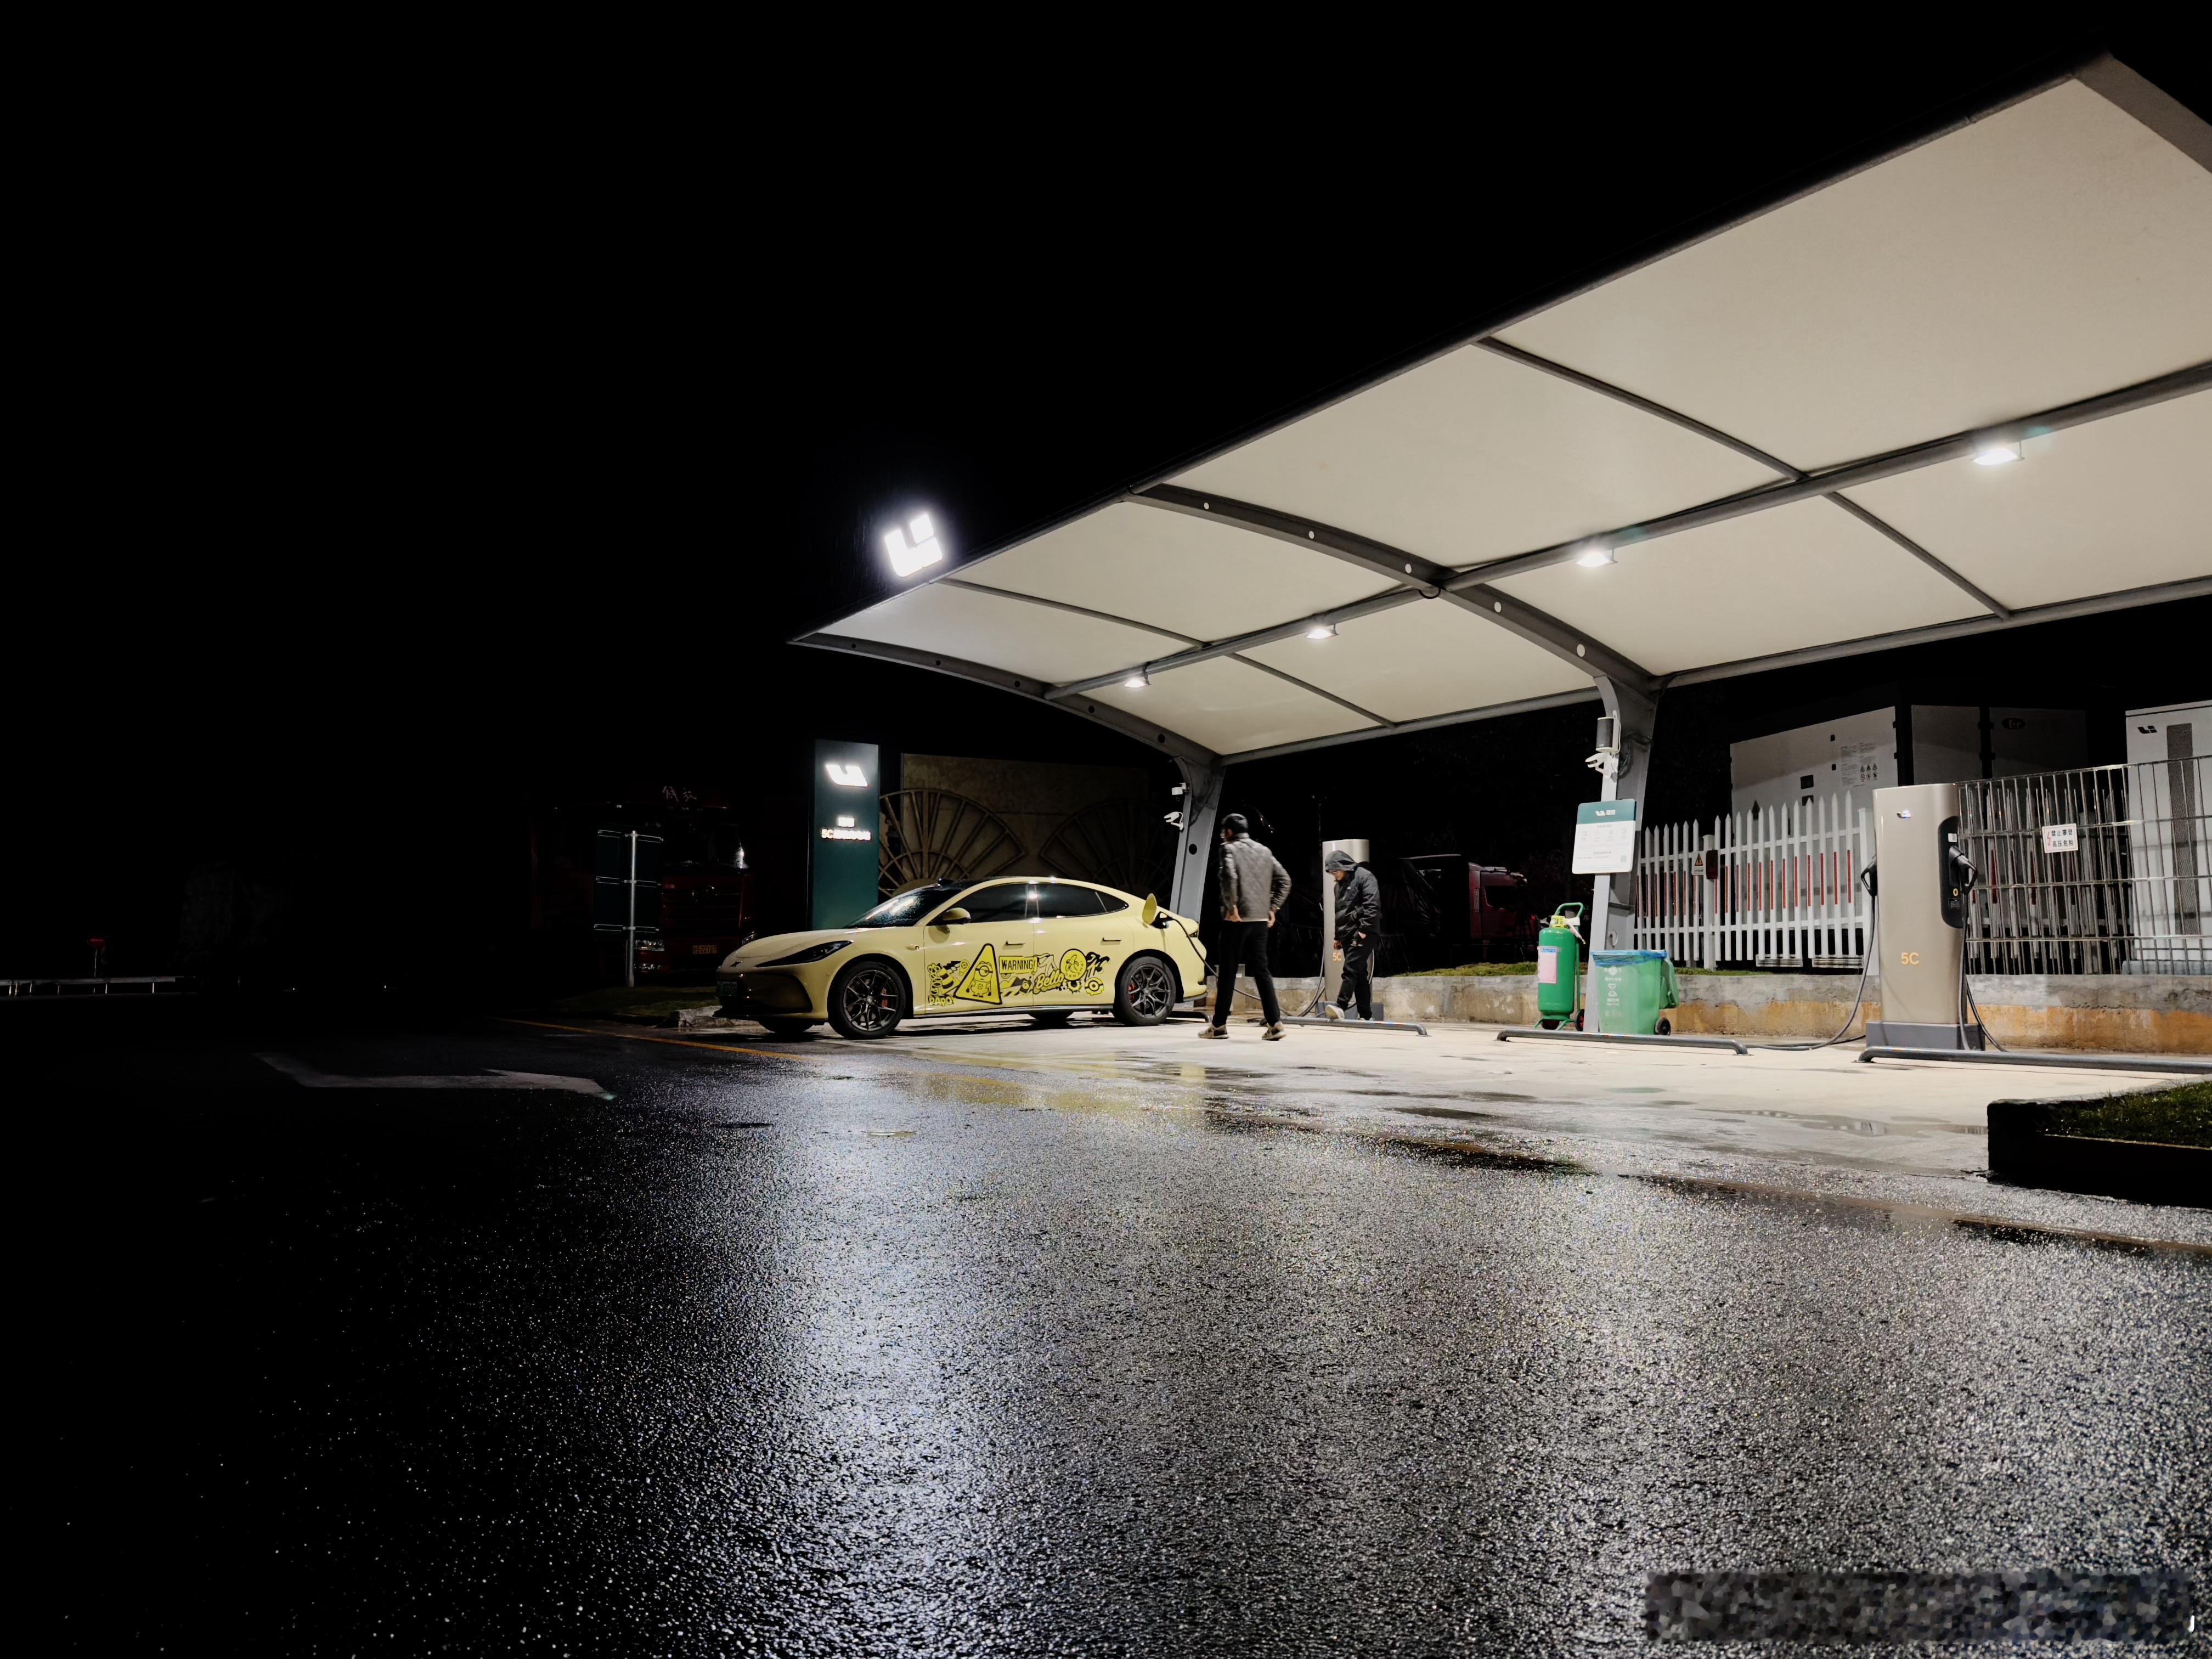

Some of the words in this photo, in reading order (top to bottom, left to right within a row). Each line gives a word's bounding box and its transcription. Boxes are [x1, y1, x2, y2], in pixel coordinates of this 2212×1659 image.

[1333, 952, 1342, 961] 5C
[1901, 952, 1919, 965] 5C
[1035, 969, 1065, 990] Bello
